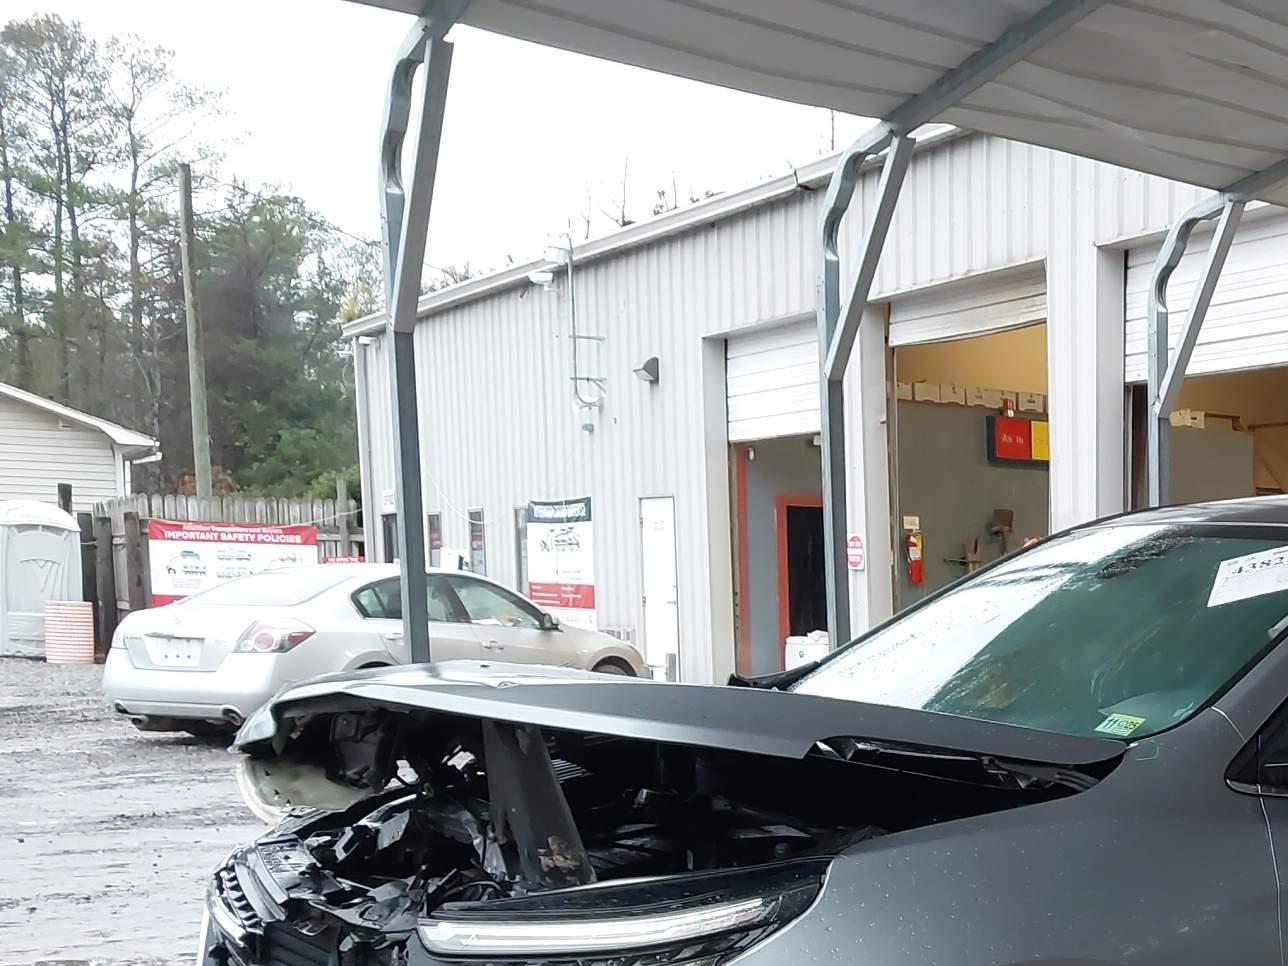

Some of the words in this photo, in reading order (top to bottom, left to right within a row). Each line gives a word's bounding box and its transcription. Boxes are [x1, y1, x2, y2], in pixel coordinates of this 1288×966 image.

[164, 530, 218, 541] IMPORTANT
[220, 532, 256, 543] SAFETY
[257, 534, 302, 544] POLICIES
